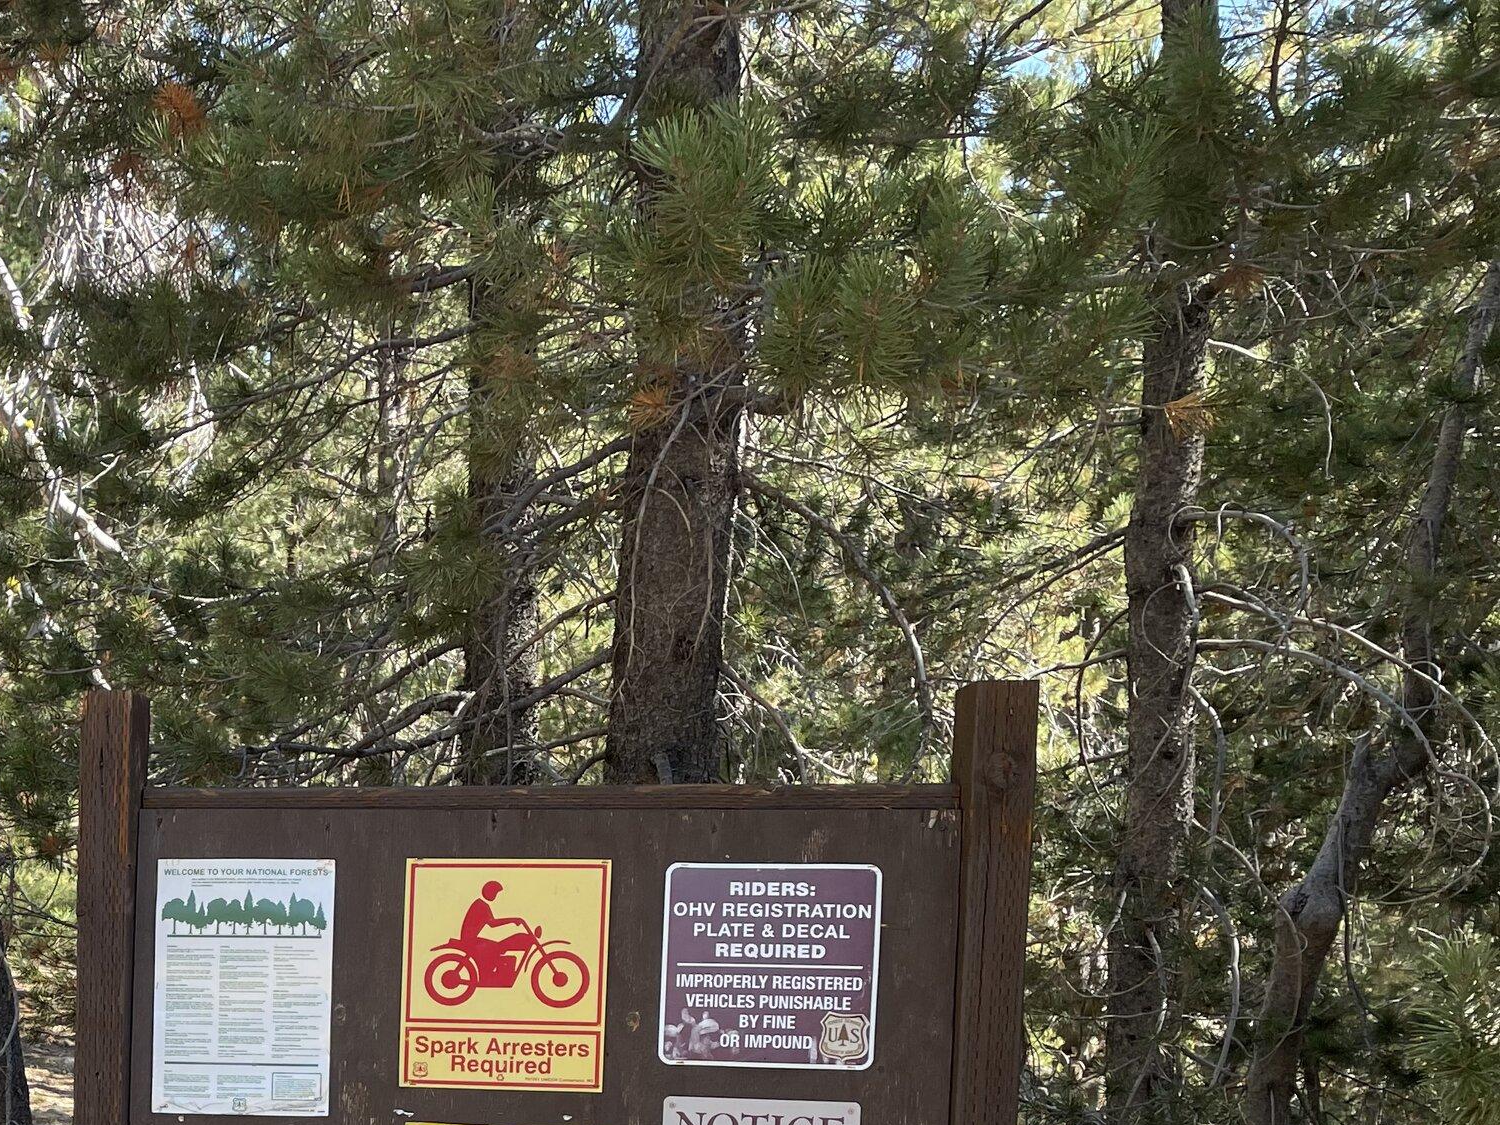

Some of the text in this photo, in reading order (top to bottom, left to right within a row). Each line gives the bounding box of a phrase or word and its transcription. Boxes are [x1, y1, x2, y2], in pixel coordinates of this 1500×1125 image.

[164, 868, 329, 877] WELCOME TO YOUR NATIONAL FORESTS
[729, 881, 816, 897] RIDERS:
[674, 902, 872, 919] OHV REGISTRATION
[693, 923, 850, 939] PLATE & DECAL
[715, 943, 826, 959] REQUIRED
[676, 974, 863, 991] IMPROPERLY REGISTERED
[686, 993, 851, 1011] VEHICLES PUNISHABLE
[739, 1015, 796, 1030] BY FINE
[415, 1036, 590, 1058] Spark Arresters
[720, 1034, 739, 1048] OR
[744, 1034, 812, 1050] IMPOUND
[451, 1055, 551, 1077] Required
